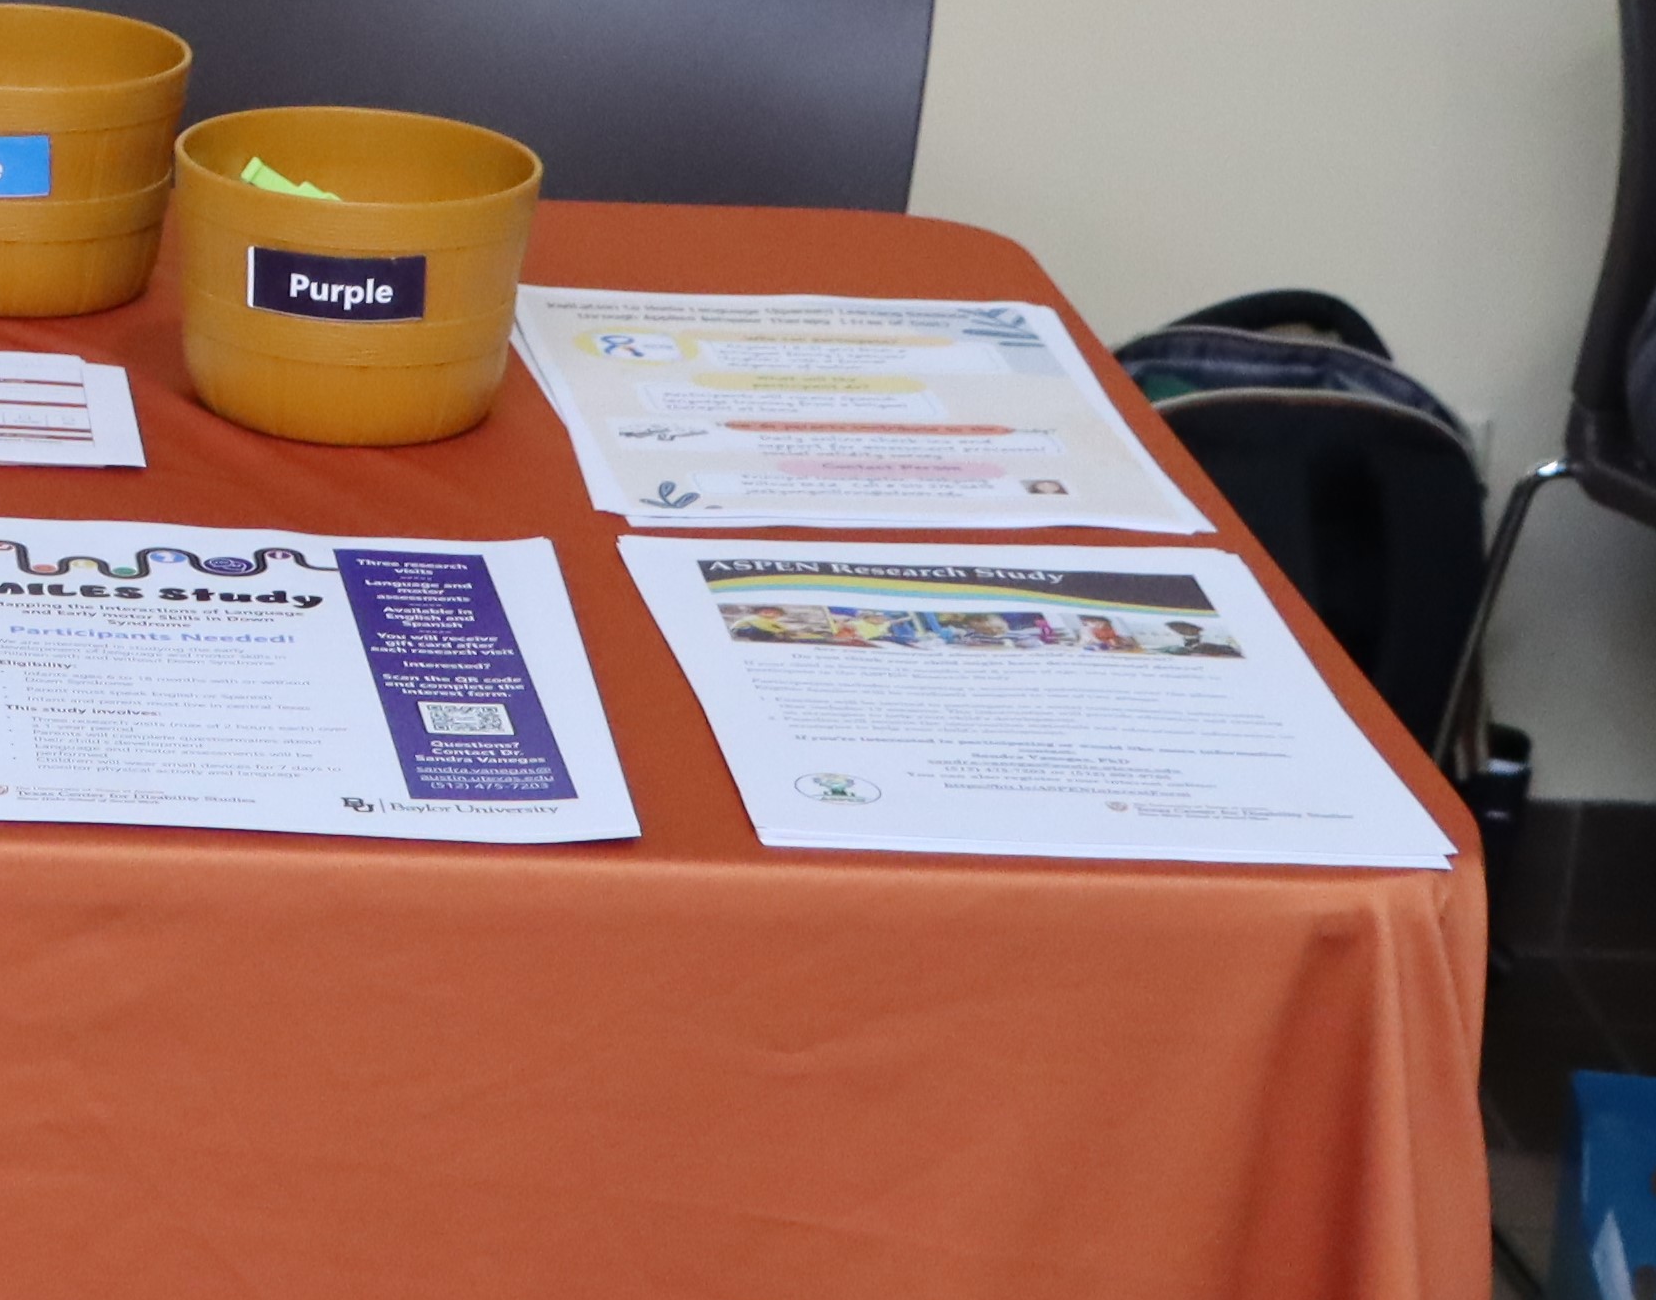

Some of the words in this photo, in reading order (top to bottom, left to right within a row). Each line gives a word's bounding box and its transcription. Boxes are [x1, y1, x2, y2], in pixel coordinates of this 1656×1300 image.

[289, 274, 393, 308] Purple
[357, 559, 400, 567] Three
[404, 562, 468, 570] research
[709, 560, 819, 572] ASPEN
[831, 563, 968, 578] Research
[975, 568, 1065, 584] Study
[365, 579, 439, 589] Language
[159, 588, 323, 608] Study
[376, 594, 471, 602] assessments
[383, 607, 454, 615] Available
[385, 613, 443, 622] English
[10, 626, 171, 641] Participants
[181, 633, 295, 643] Needed!
[0, 660, 76, 669] Eligibility:
[430, 741, 519, 749] Questions?
[432, 748, 494, 756] Contact
[415, 755, 473, 763] Sandra
[390, 803, 453, 814] Baylor
[457, 805, 558, 814] University
